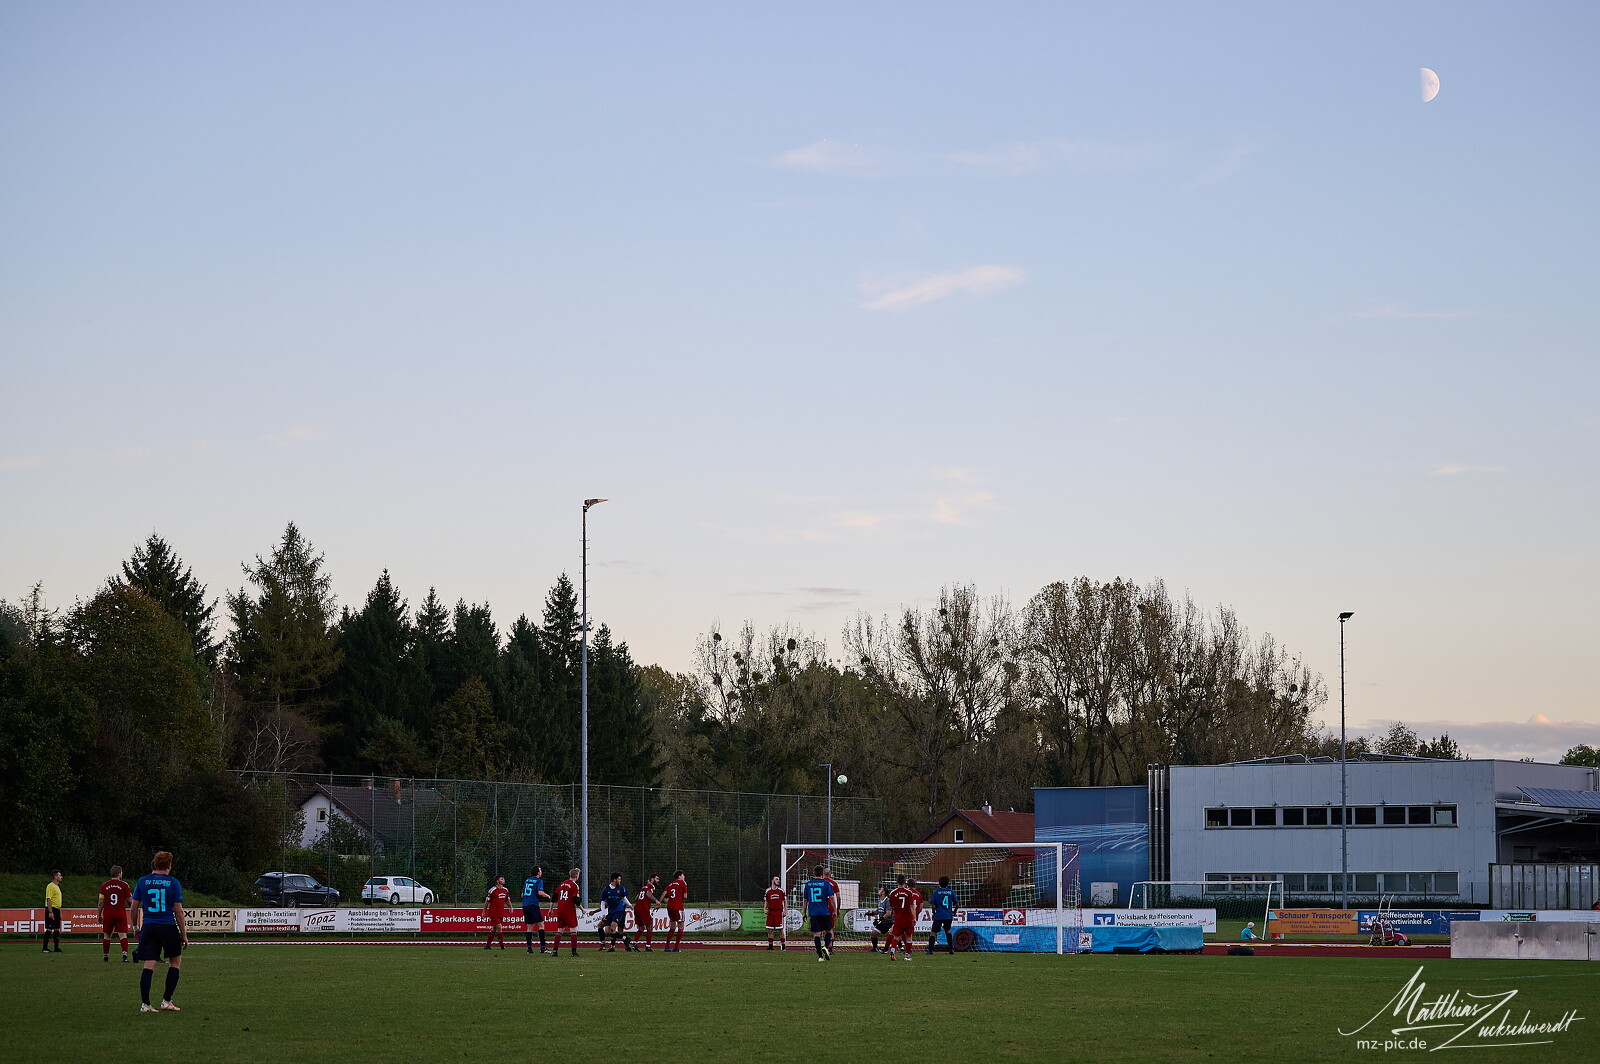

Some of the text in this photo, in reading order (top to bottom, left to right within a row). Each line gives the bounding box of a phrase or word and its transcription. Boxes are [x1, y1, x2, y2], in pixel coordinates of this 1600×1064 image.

[560, 889, 568, 900] 14
[670, 888, 676, 898] 3
[810, 888, 822, 902] 12
[110, 893, 118, 906] 9
[148, 888, 166, 912] 31
[898, 896, 906, 908] 7
[942, 896, 950, 908] 4
[304, 910, 336, 926] Topaz
[435, 916, 474, 924] Sparkasse
[1116, 913, 1193, 921] Volksbank Raiffeisenbank
[1312, 912, 1352, 920] Transporte
